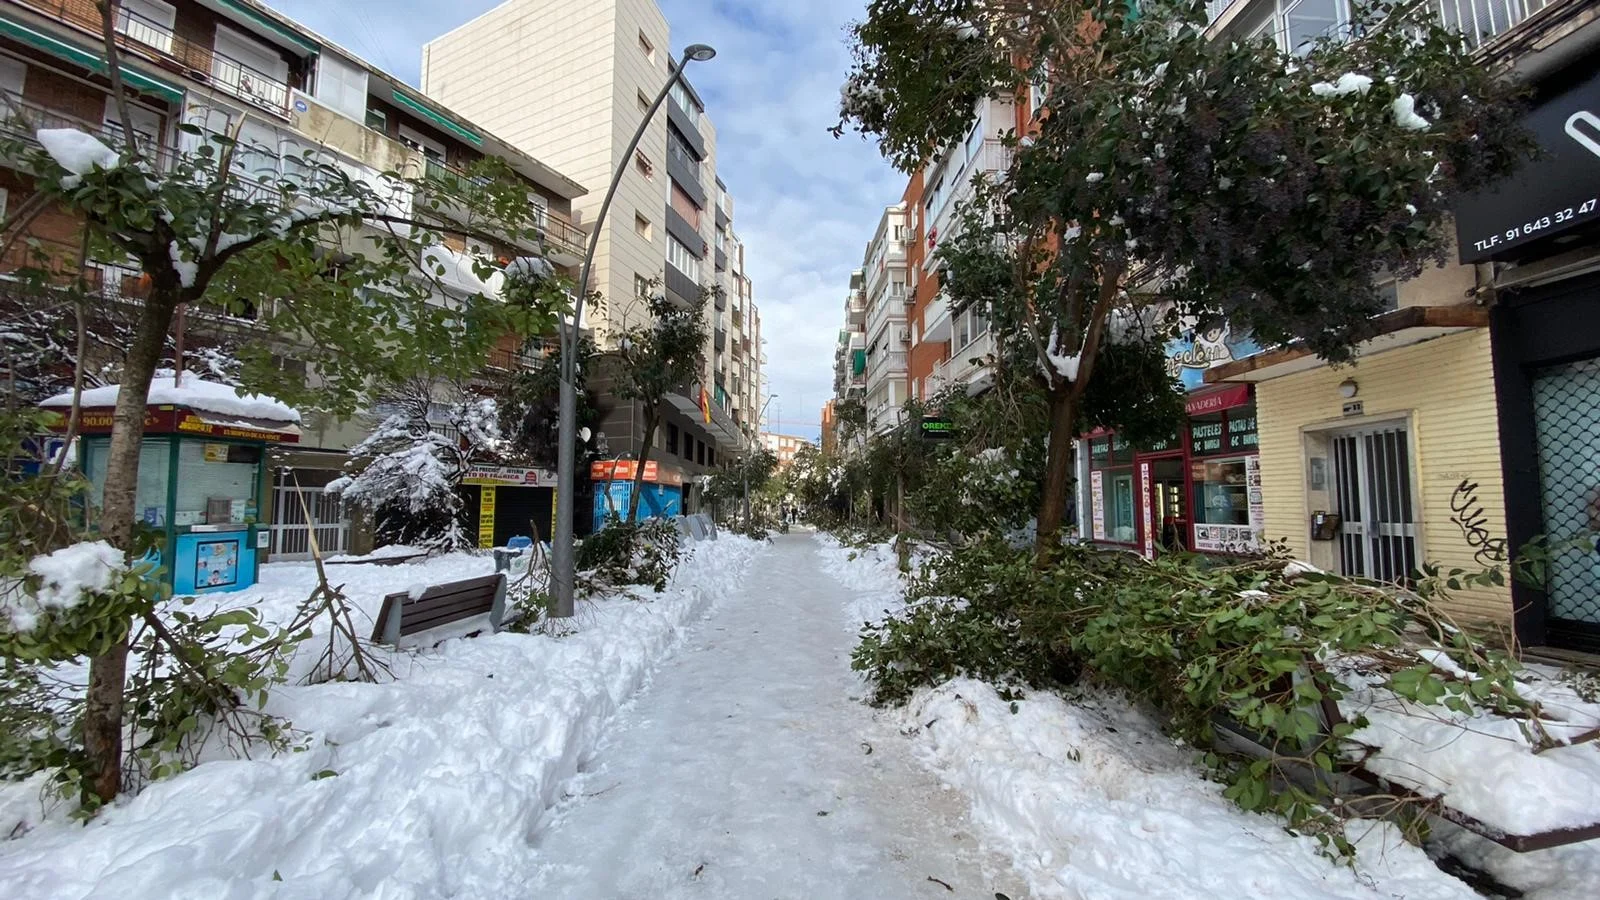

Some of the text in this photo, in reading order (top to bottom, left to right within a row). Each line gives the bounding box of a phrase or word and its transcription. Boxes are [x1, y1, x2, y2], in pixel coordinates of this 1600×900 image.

[1474, 198, 1597, 251] TLF. 91 643 32 47
[1193, 423, 1222, 439] PASTELES
[1229, 419, 1247, 433] PASTAS
